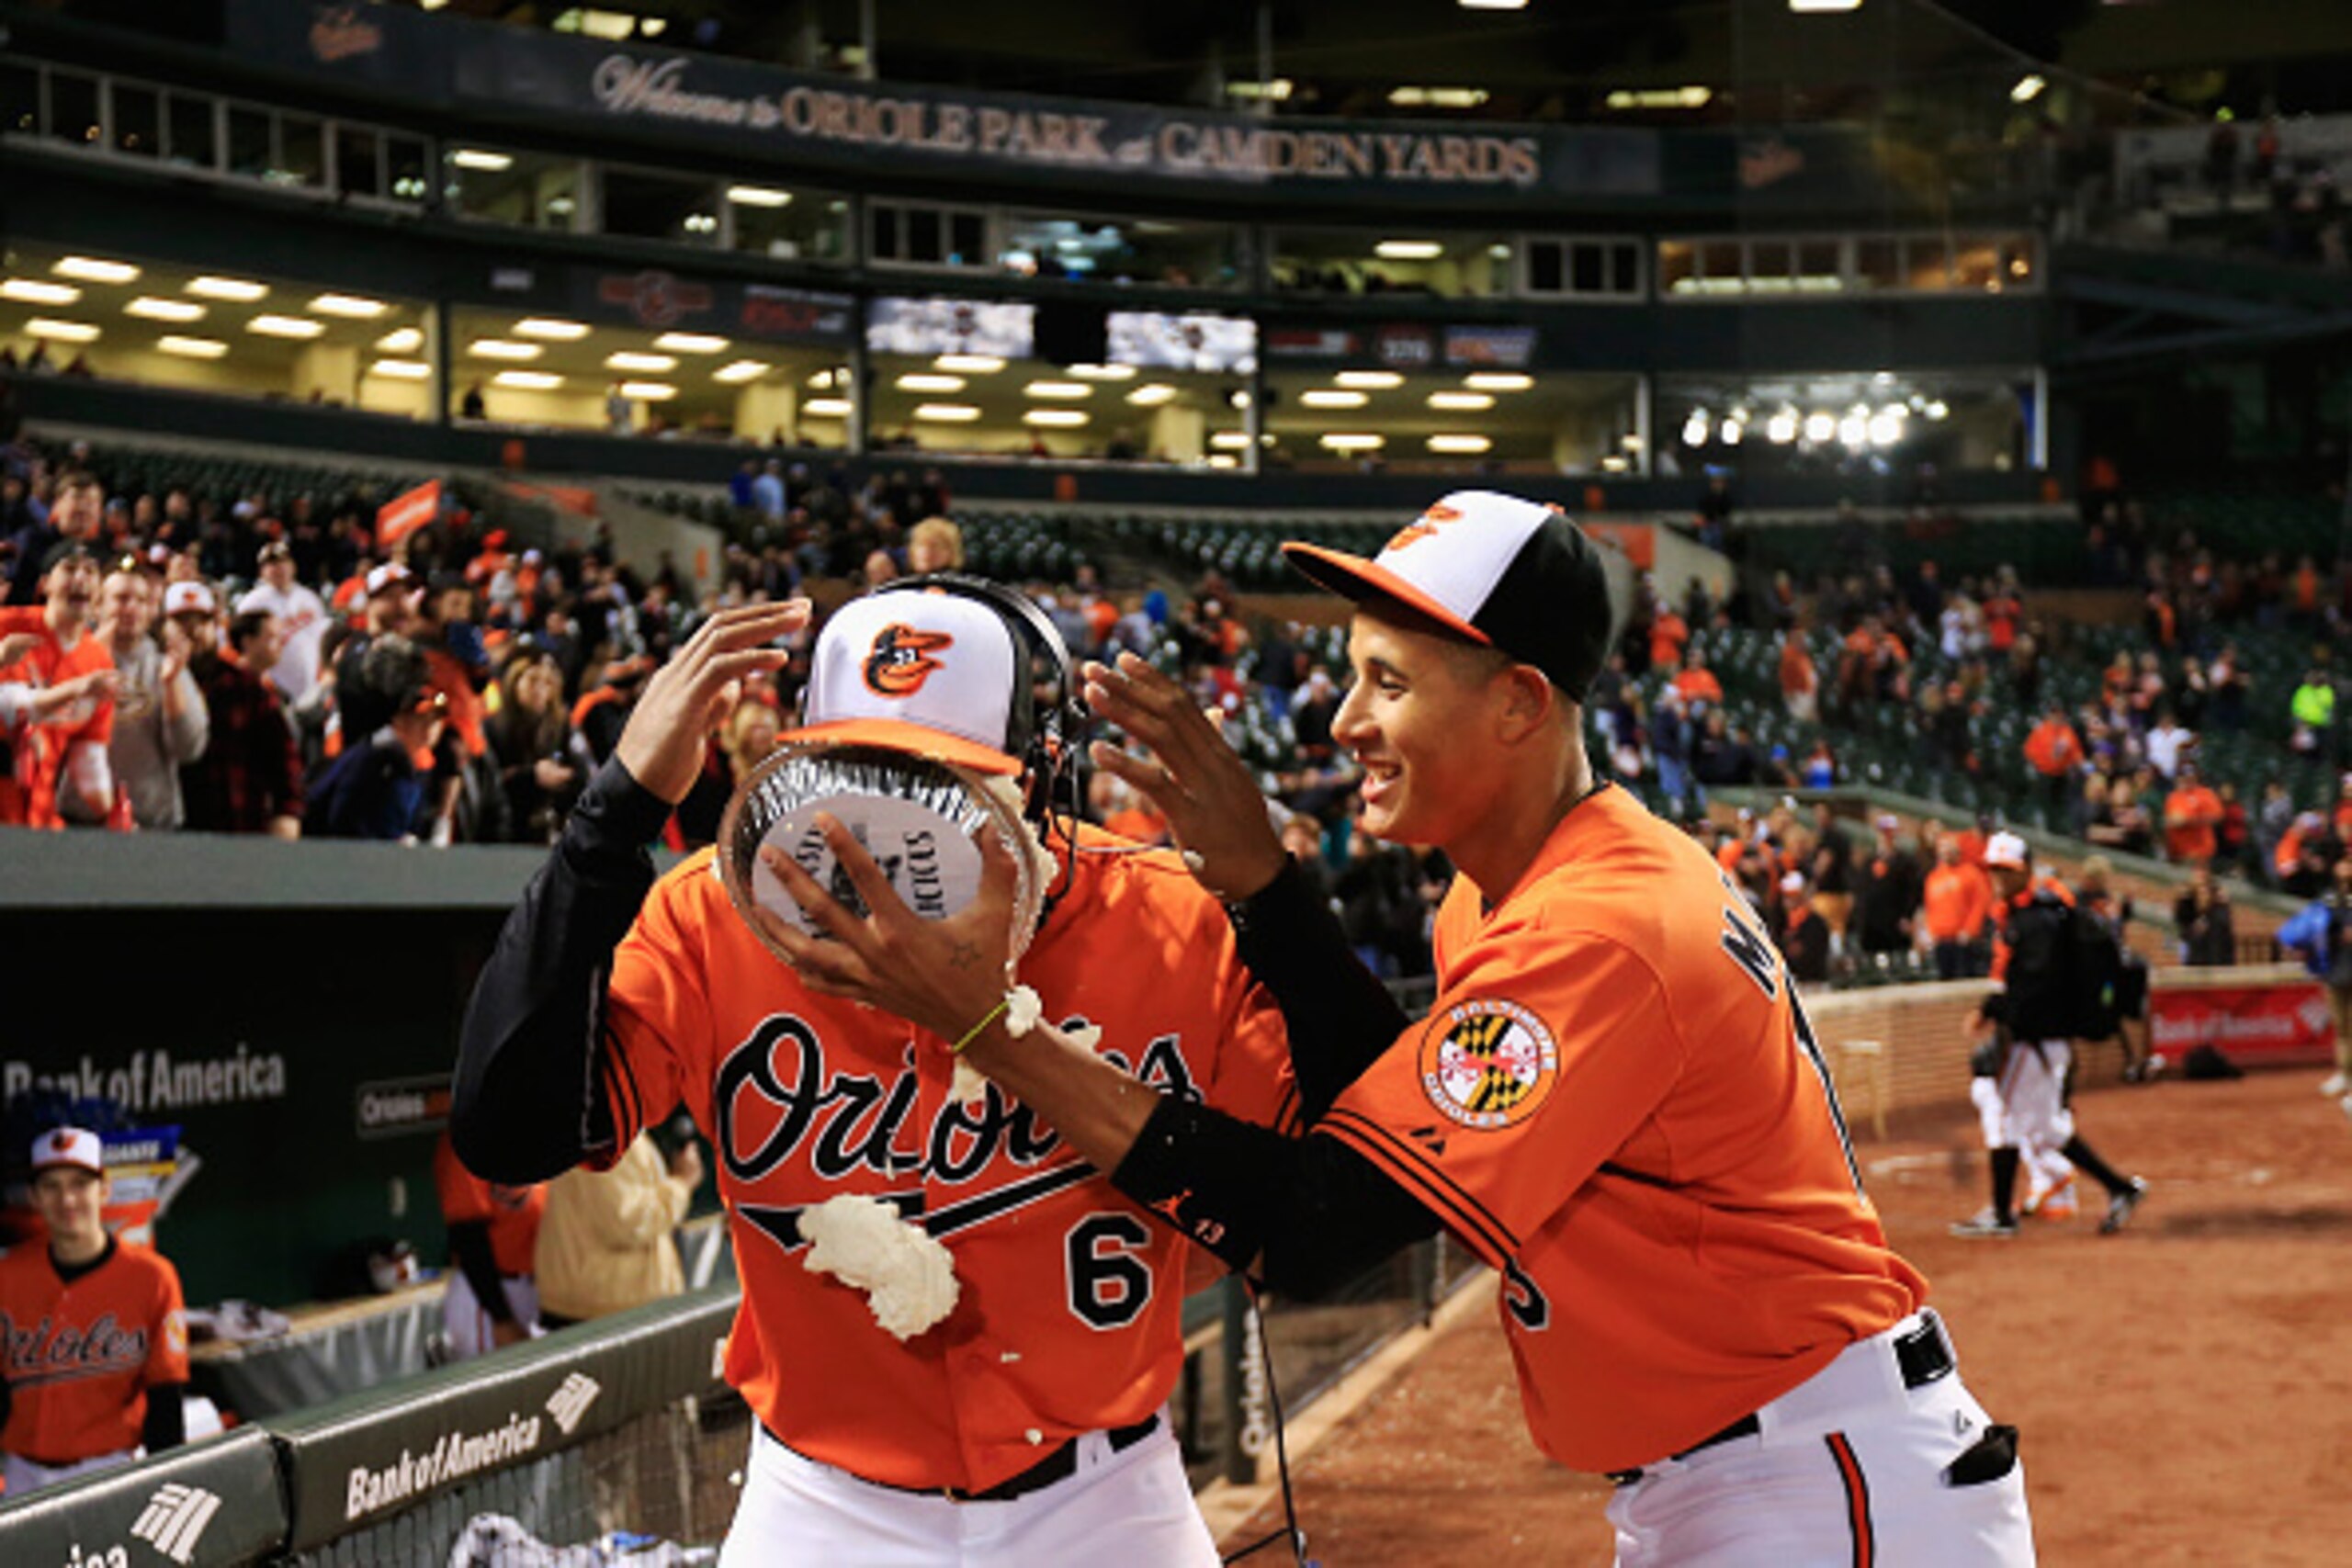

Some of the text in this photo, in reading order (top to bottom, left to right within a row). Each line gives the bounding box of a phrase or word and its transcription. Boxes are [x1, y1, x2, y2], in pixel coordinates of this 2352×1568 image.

[592, 54, 745, 125] Welcome
[782, 86, 972, 152] ORIOLE
[977, 107, 1110, 164] PARK
[1159, 122, 1375, 180] CAMDEN
[1376, 133, 1539, 182] YARDS
[150, 1042, 286, 1110] America
[716, 1012, 1204, 1183] Oriols
[1065, 1211, 1152, 1331] 6
[1194, 1219, 1226, 1245] 13
[346, 1412, 540, 1520] Bank of America
